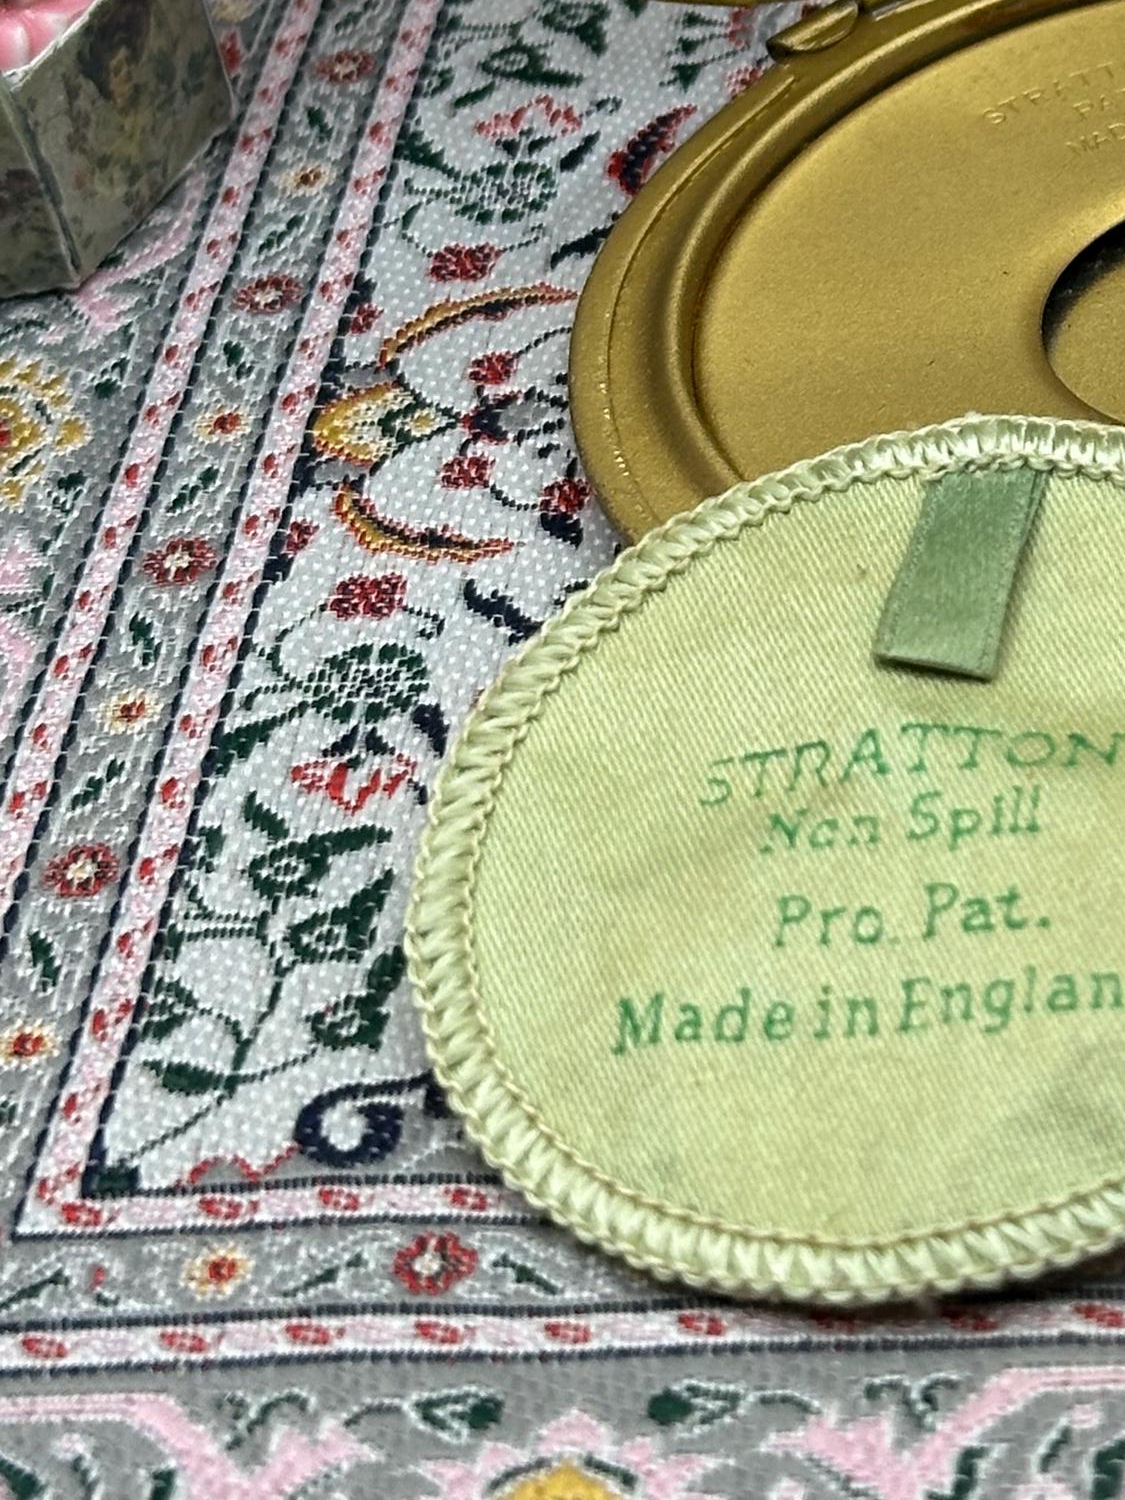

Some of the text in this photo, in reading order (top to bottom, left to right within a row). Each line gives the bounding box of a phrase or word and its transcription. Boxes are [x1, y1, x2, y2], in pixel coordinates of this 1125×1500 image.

[906, 784, 1040, 852] Spill
[921, 882, 1051, 943] Pat.
[611, 986, 797, 1055] Made
[813, 984, 881, 1041] in
